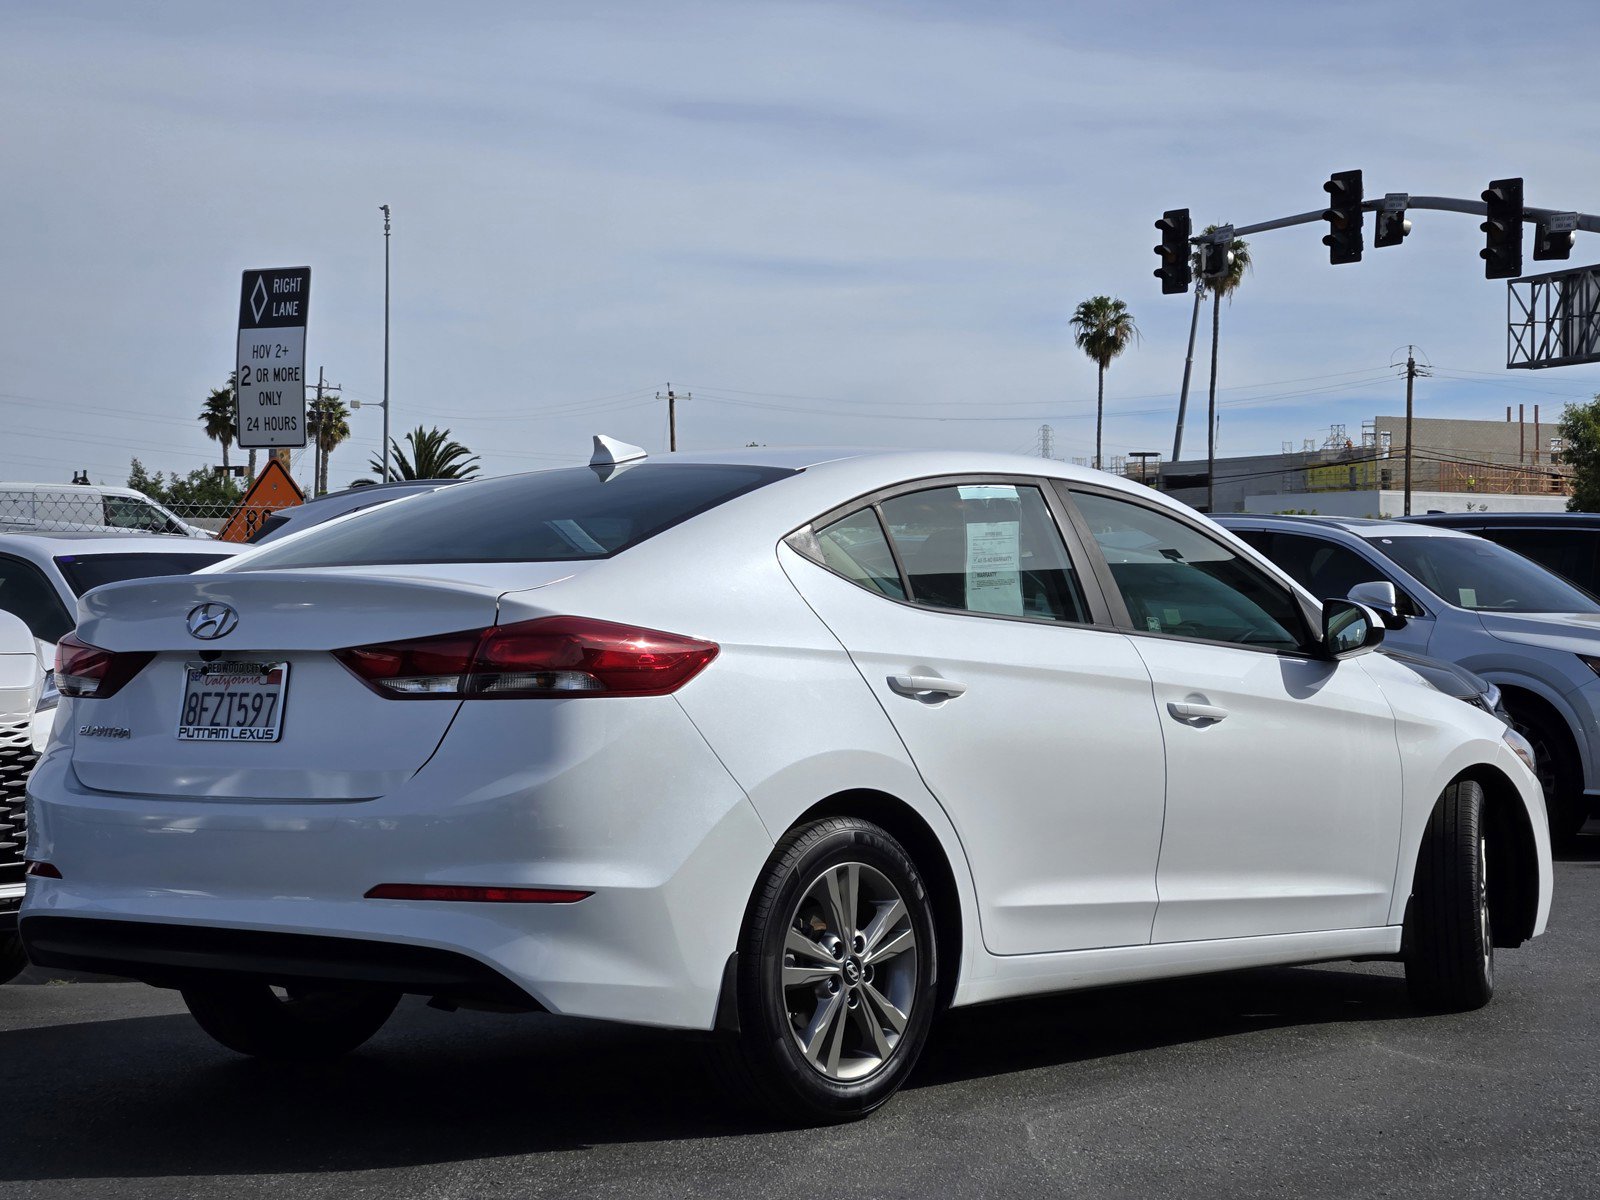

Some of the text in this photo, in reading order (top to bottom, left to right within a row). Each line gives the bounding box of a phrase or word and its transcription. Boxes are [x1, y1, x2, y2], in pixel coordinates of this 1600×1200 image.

[273, 277, 302, 294] RIGHT
[272, 301, 299, 317] LANE
[252, 344, 289, 359] HOV 2+
[241, 365, 300, 386] 2 OR MORE
[258, 391, 283, 406] ONLY
[246, 416, 297, 432] 24 HOURS
[207, 662, 244, 673] REDWOOD
[186, 692, 277, 726] 8FZT597
[79, 725, 131, 739] ELANTRA
[178, 727, 274, 739] PUTNAM LEXUS
